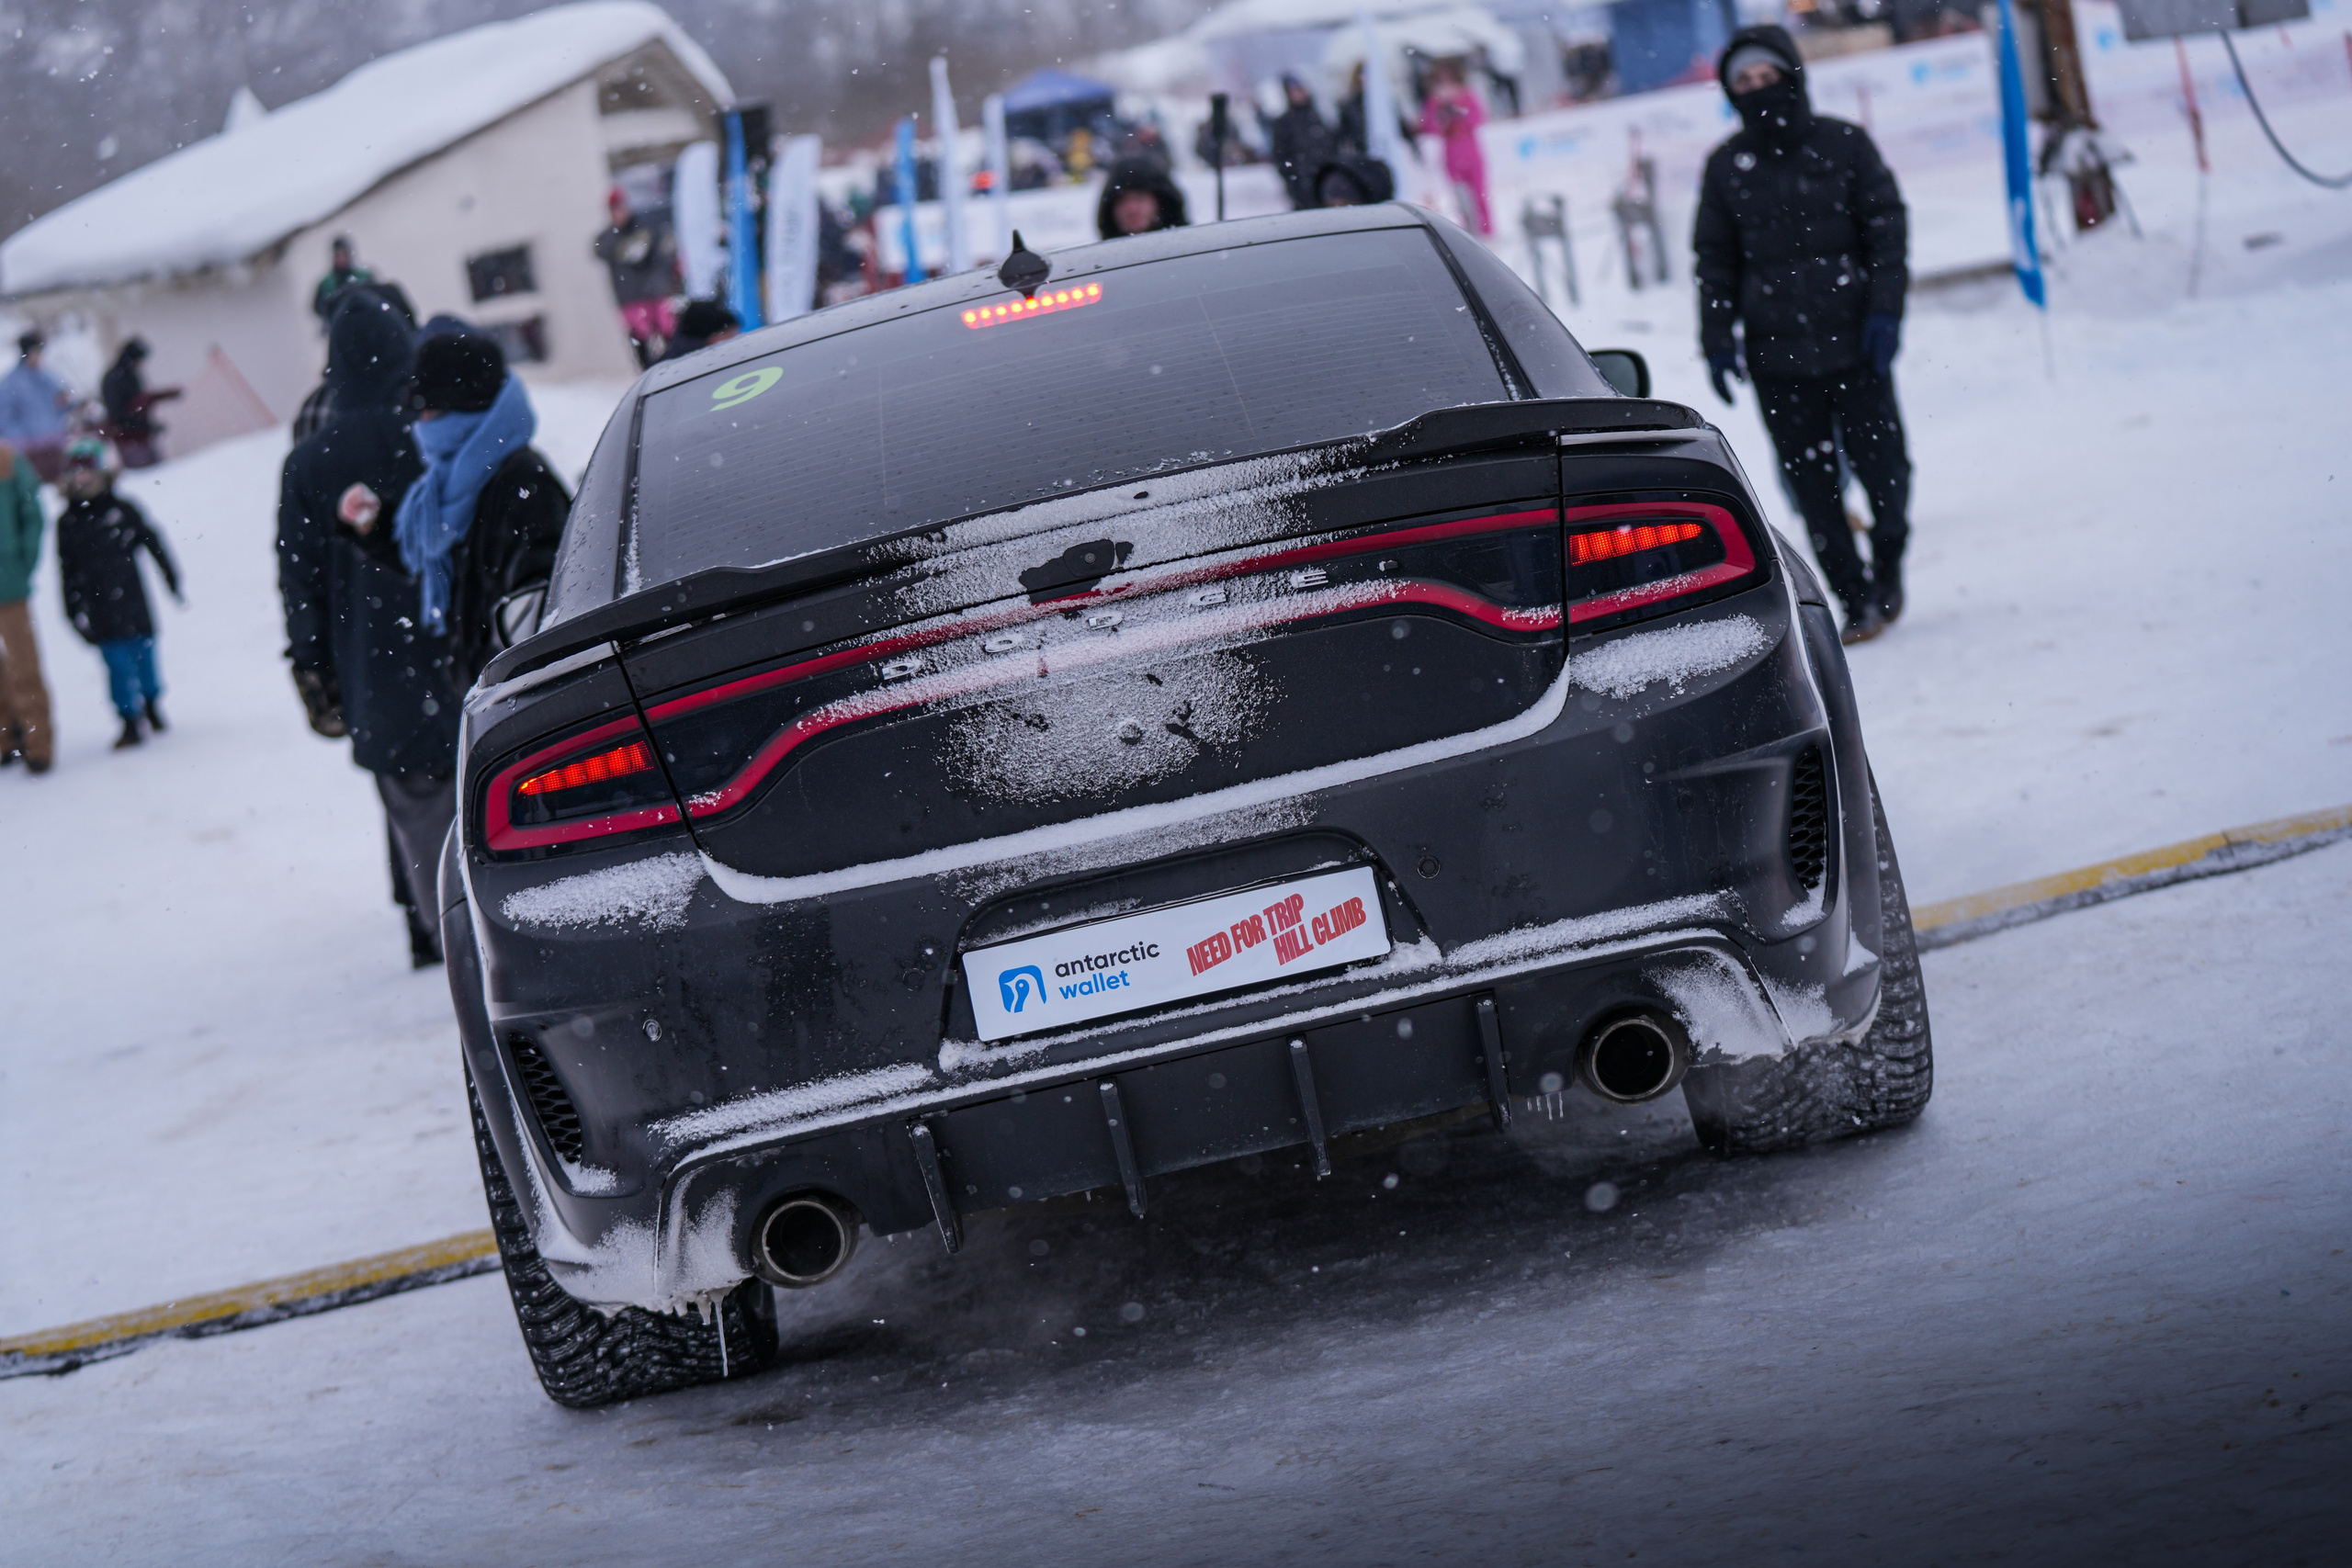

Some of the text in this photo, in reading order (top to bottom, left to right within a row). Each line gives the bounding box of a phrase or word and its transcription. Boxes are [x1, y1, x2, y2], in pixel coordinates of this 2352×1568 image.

[709, 367, 784, 412] 9
[1186, 893, 1305, 976] NEED FOR TRIP
[1272, 897, 1367, 966] HILL CLIMB
[1055, 941, 1160, 977] antarctic
[1058, 970, 1130, 999] wallet
